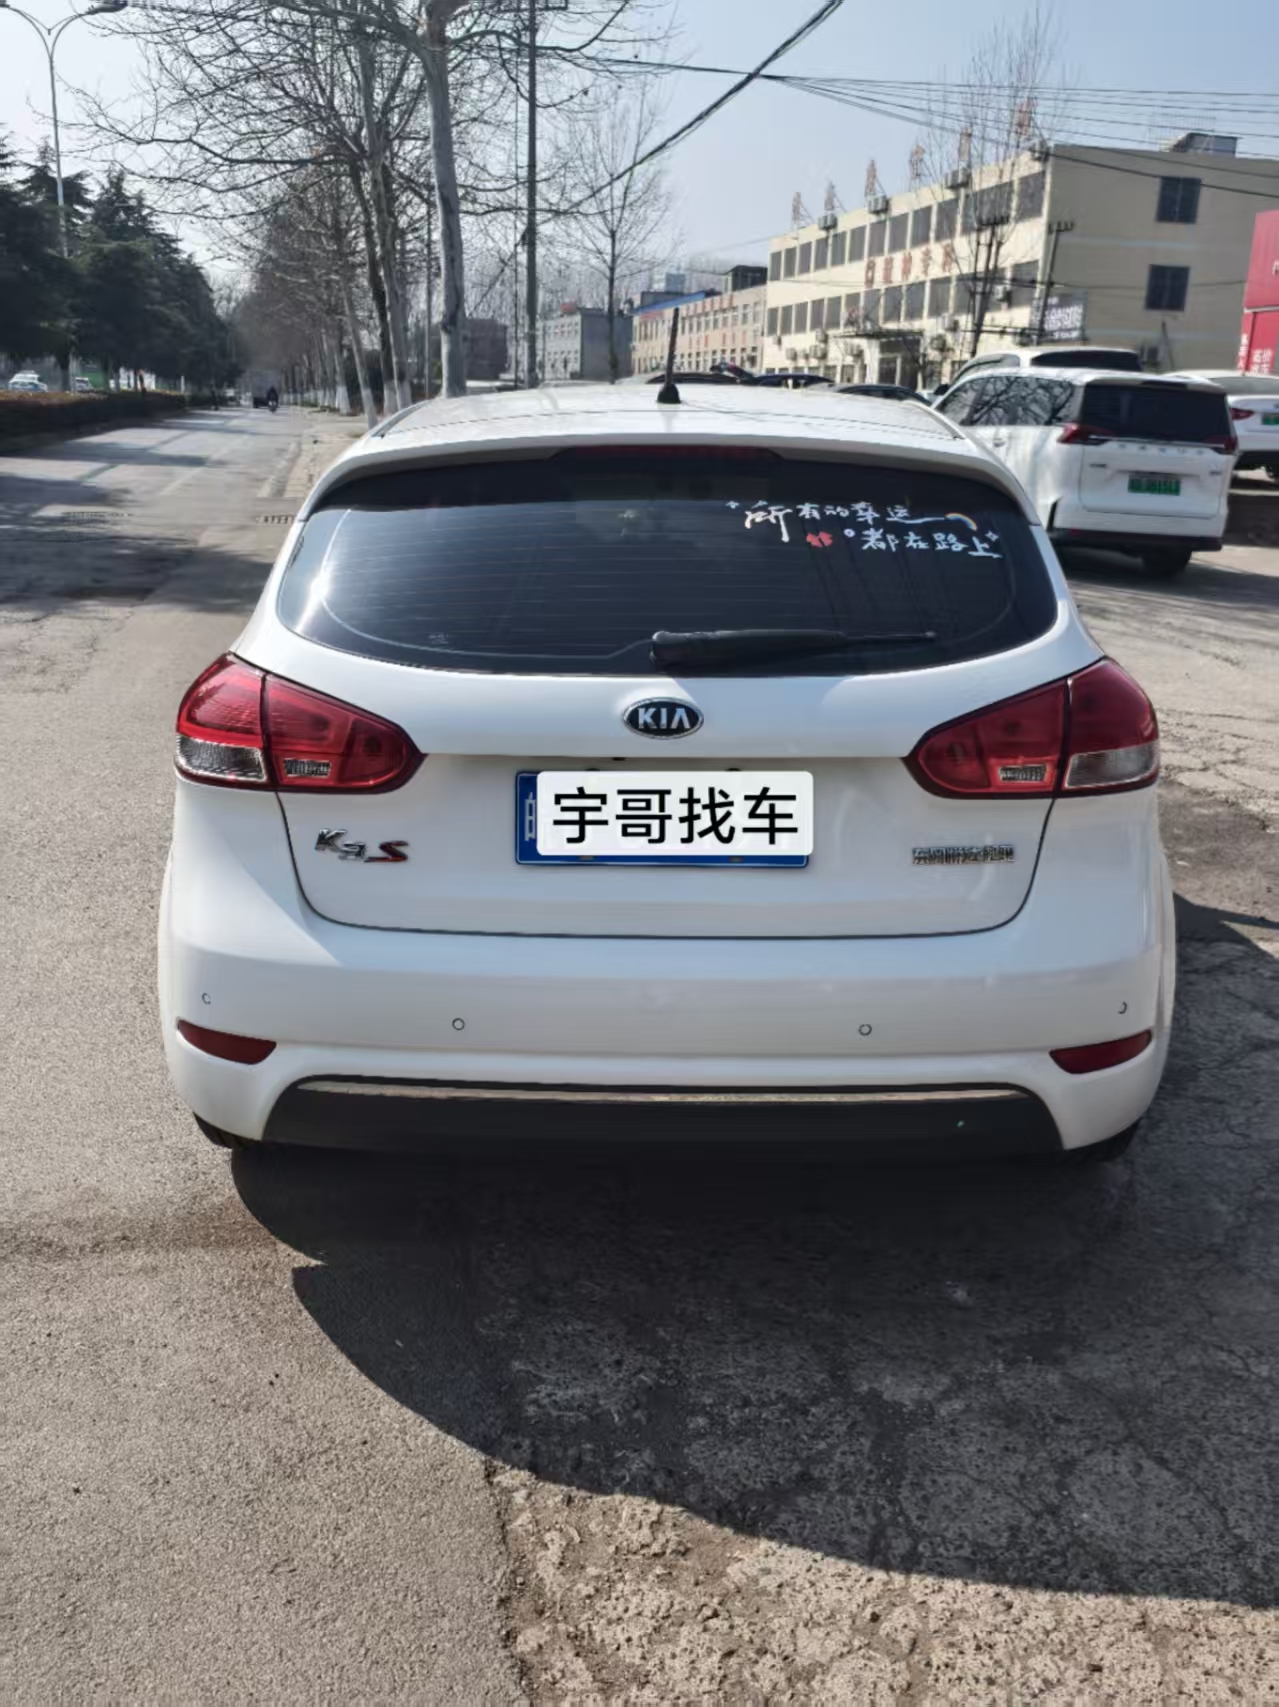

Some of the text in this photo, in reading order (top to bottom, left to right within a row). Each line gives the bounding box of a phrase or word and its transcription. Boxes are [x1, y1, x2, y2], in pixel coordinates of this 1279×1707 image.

[861, 527, 1003, 558] 都在路上
[638, 707, 691, 729] KIA
